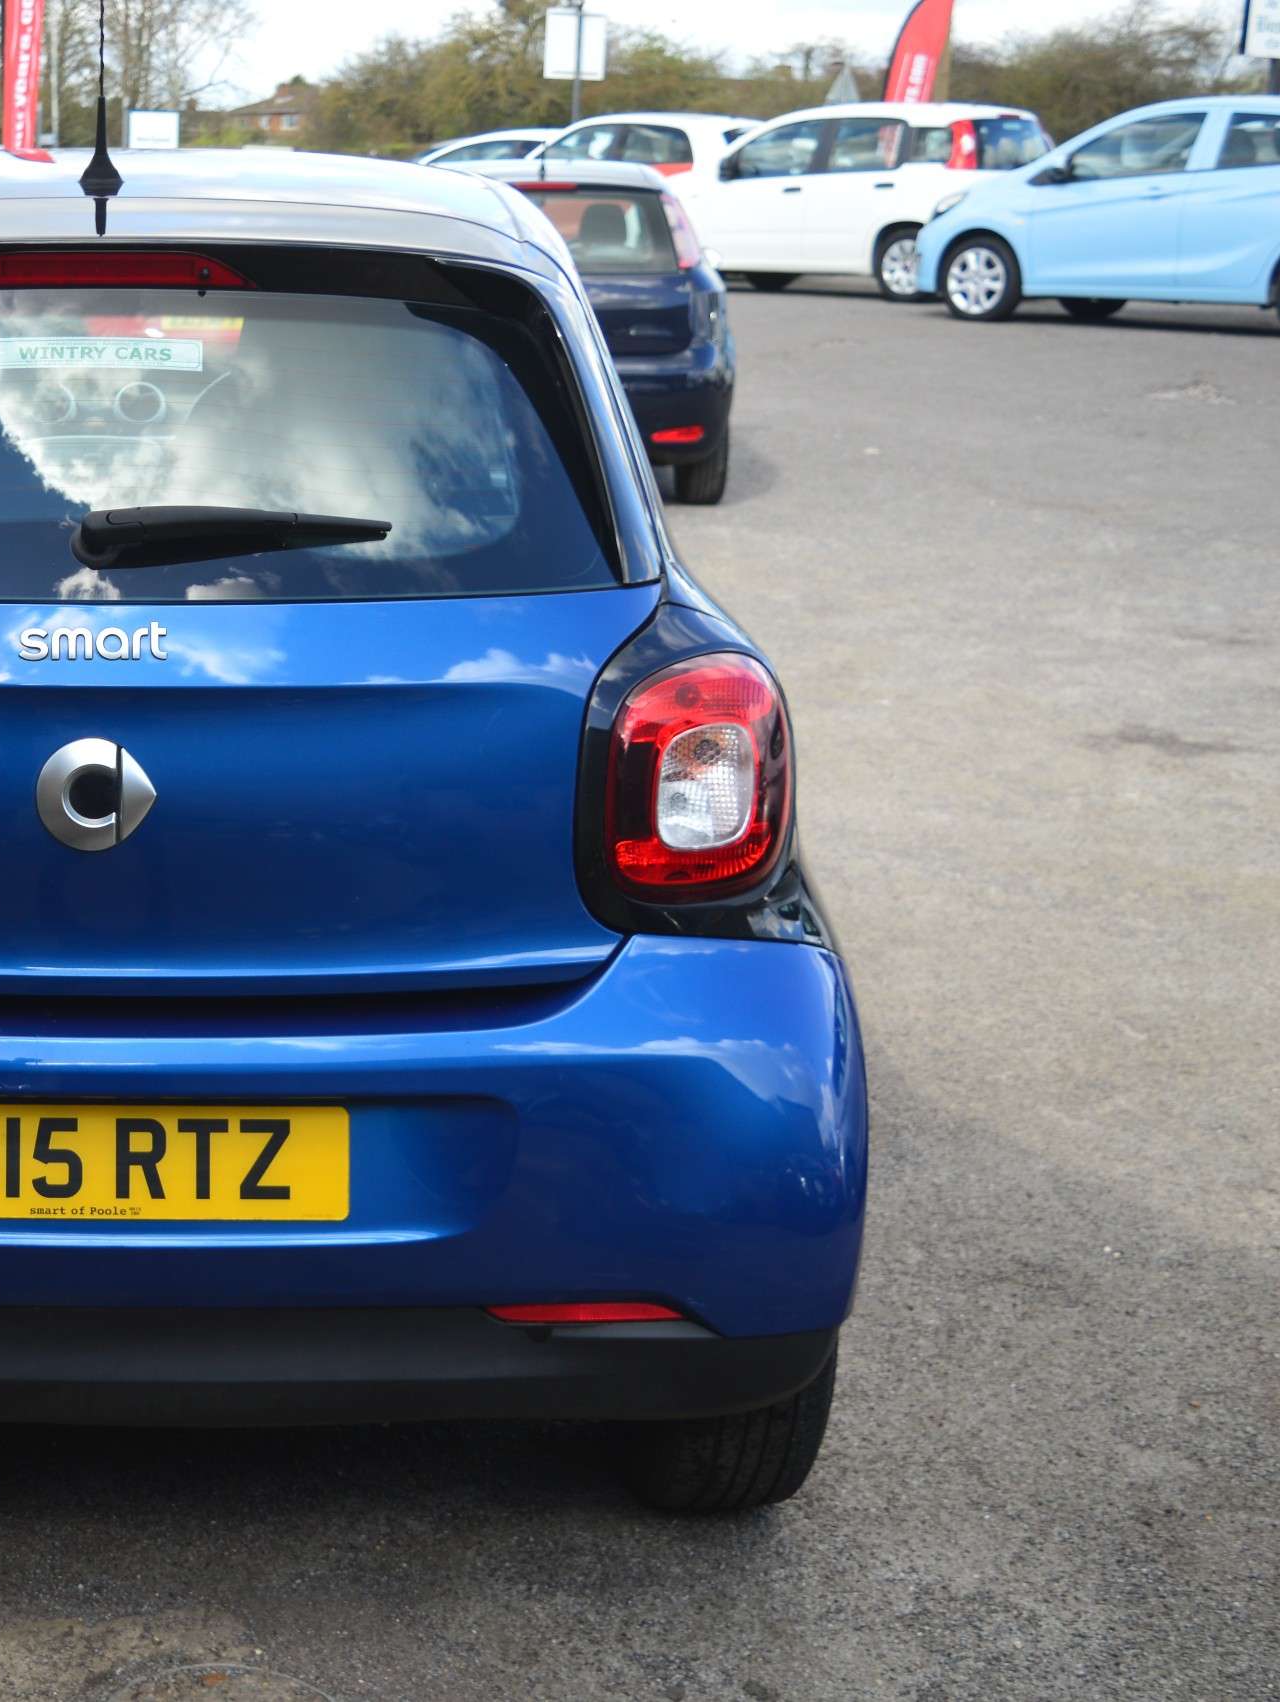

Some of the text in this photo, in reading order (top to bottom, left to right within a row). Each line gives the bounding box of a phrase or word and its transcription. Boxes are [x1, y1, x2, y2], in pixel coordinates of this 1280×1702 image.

[19, 346, 172, 361] WINTRY CARS
[19, 621, 168, 662] smart
[115, 1117, 291, 1200] RTZ
[29, 1205, 67, 1216] smart
[71, 1205, 86, 1216] of
[89, 1205, 128, 1216] Poole
